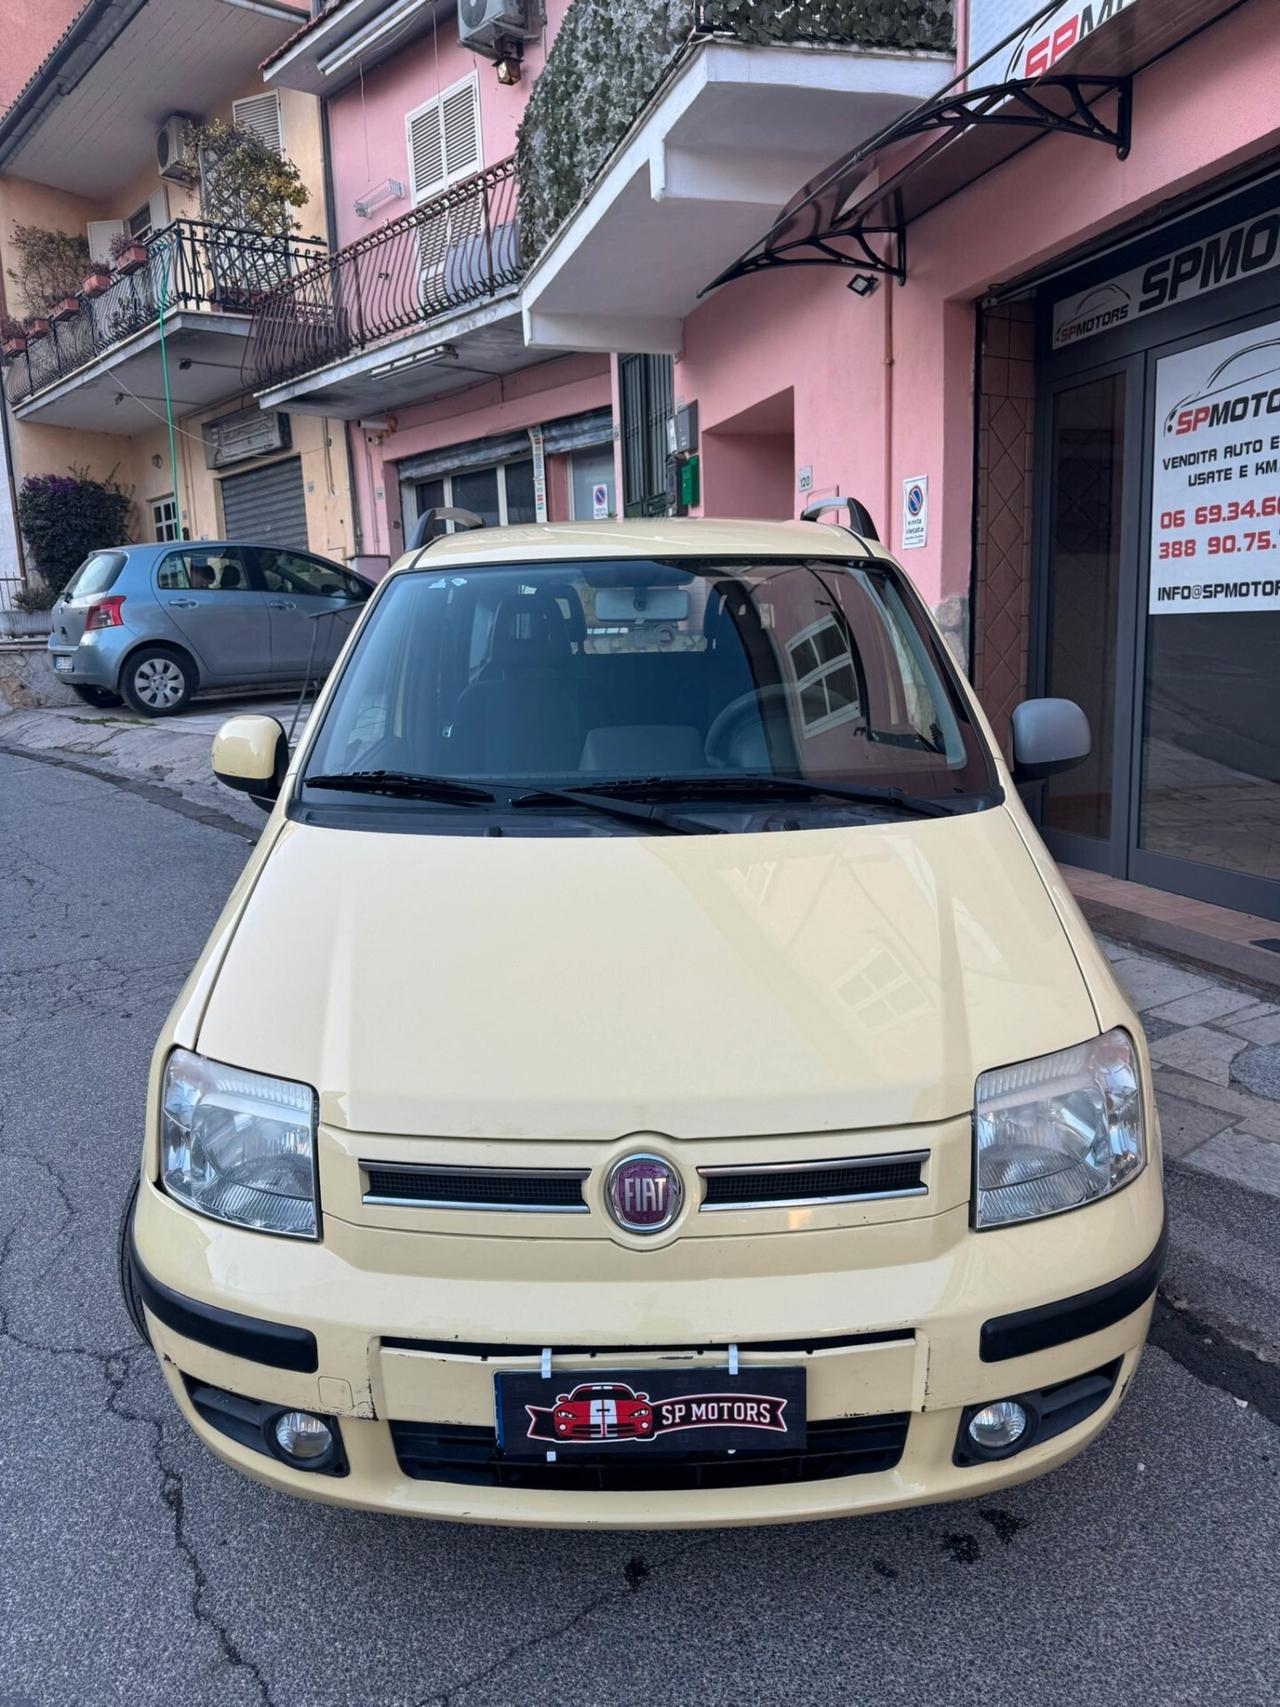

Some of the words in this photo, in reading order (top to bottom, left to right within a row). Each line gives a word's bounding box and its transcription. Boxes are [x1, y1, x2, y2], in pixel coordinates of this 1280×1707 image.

[1061, 304, 1129, 342] SPMOTORS
[1163, 449, 1217, 470] VENDITA
[1224, 439, 1263, 459] AUTO
[800, 475, 810, 488] 120
[1188, 467, 1232, 487] USATE
[1239, 465, 1248, 478] E
[1160, 510, 1185, 529] 06
[1195, 496, 1280, 525] 69.34.6
[1159, 539, 1196, 559] 388
[1208, 529, 1280, 554] 90.75.
[624, 1177, 667, 1212] FIAT
[662, 1404, 686, 1425] SP
[691, 1402, 770, 1424] MOTORS
